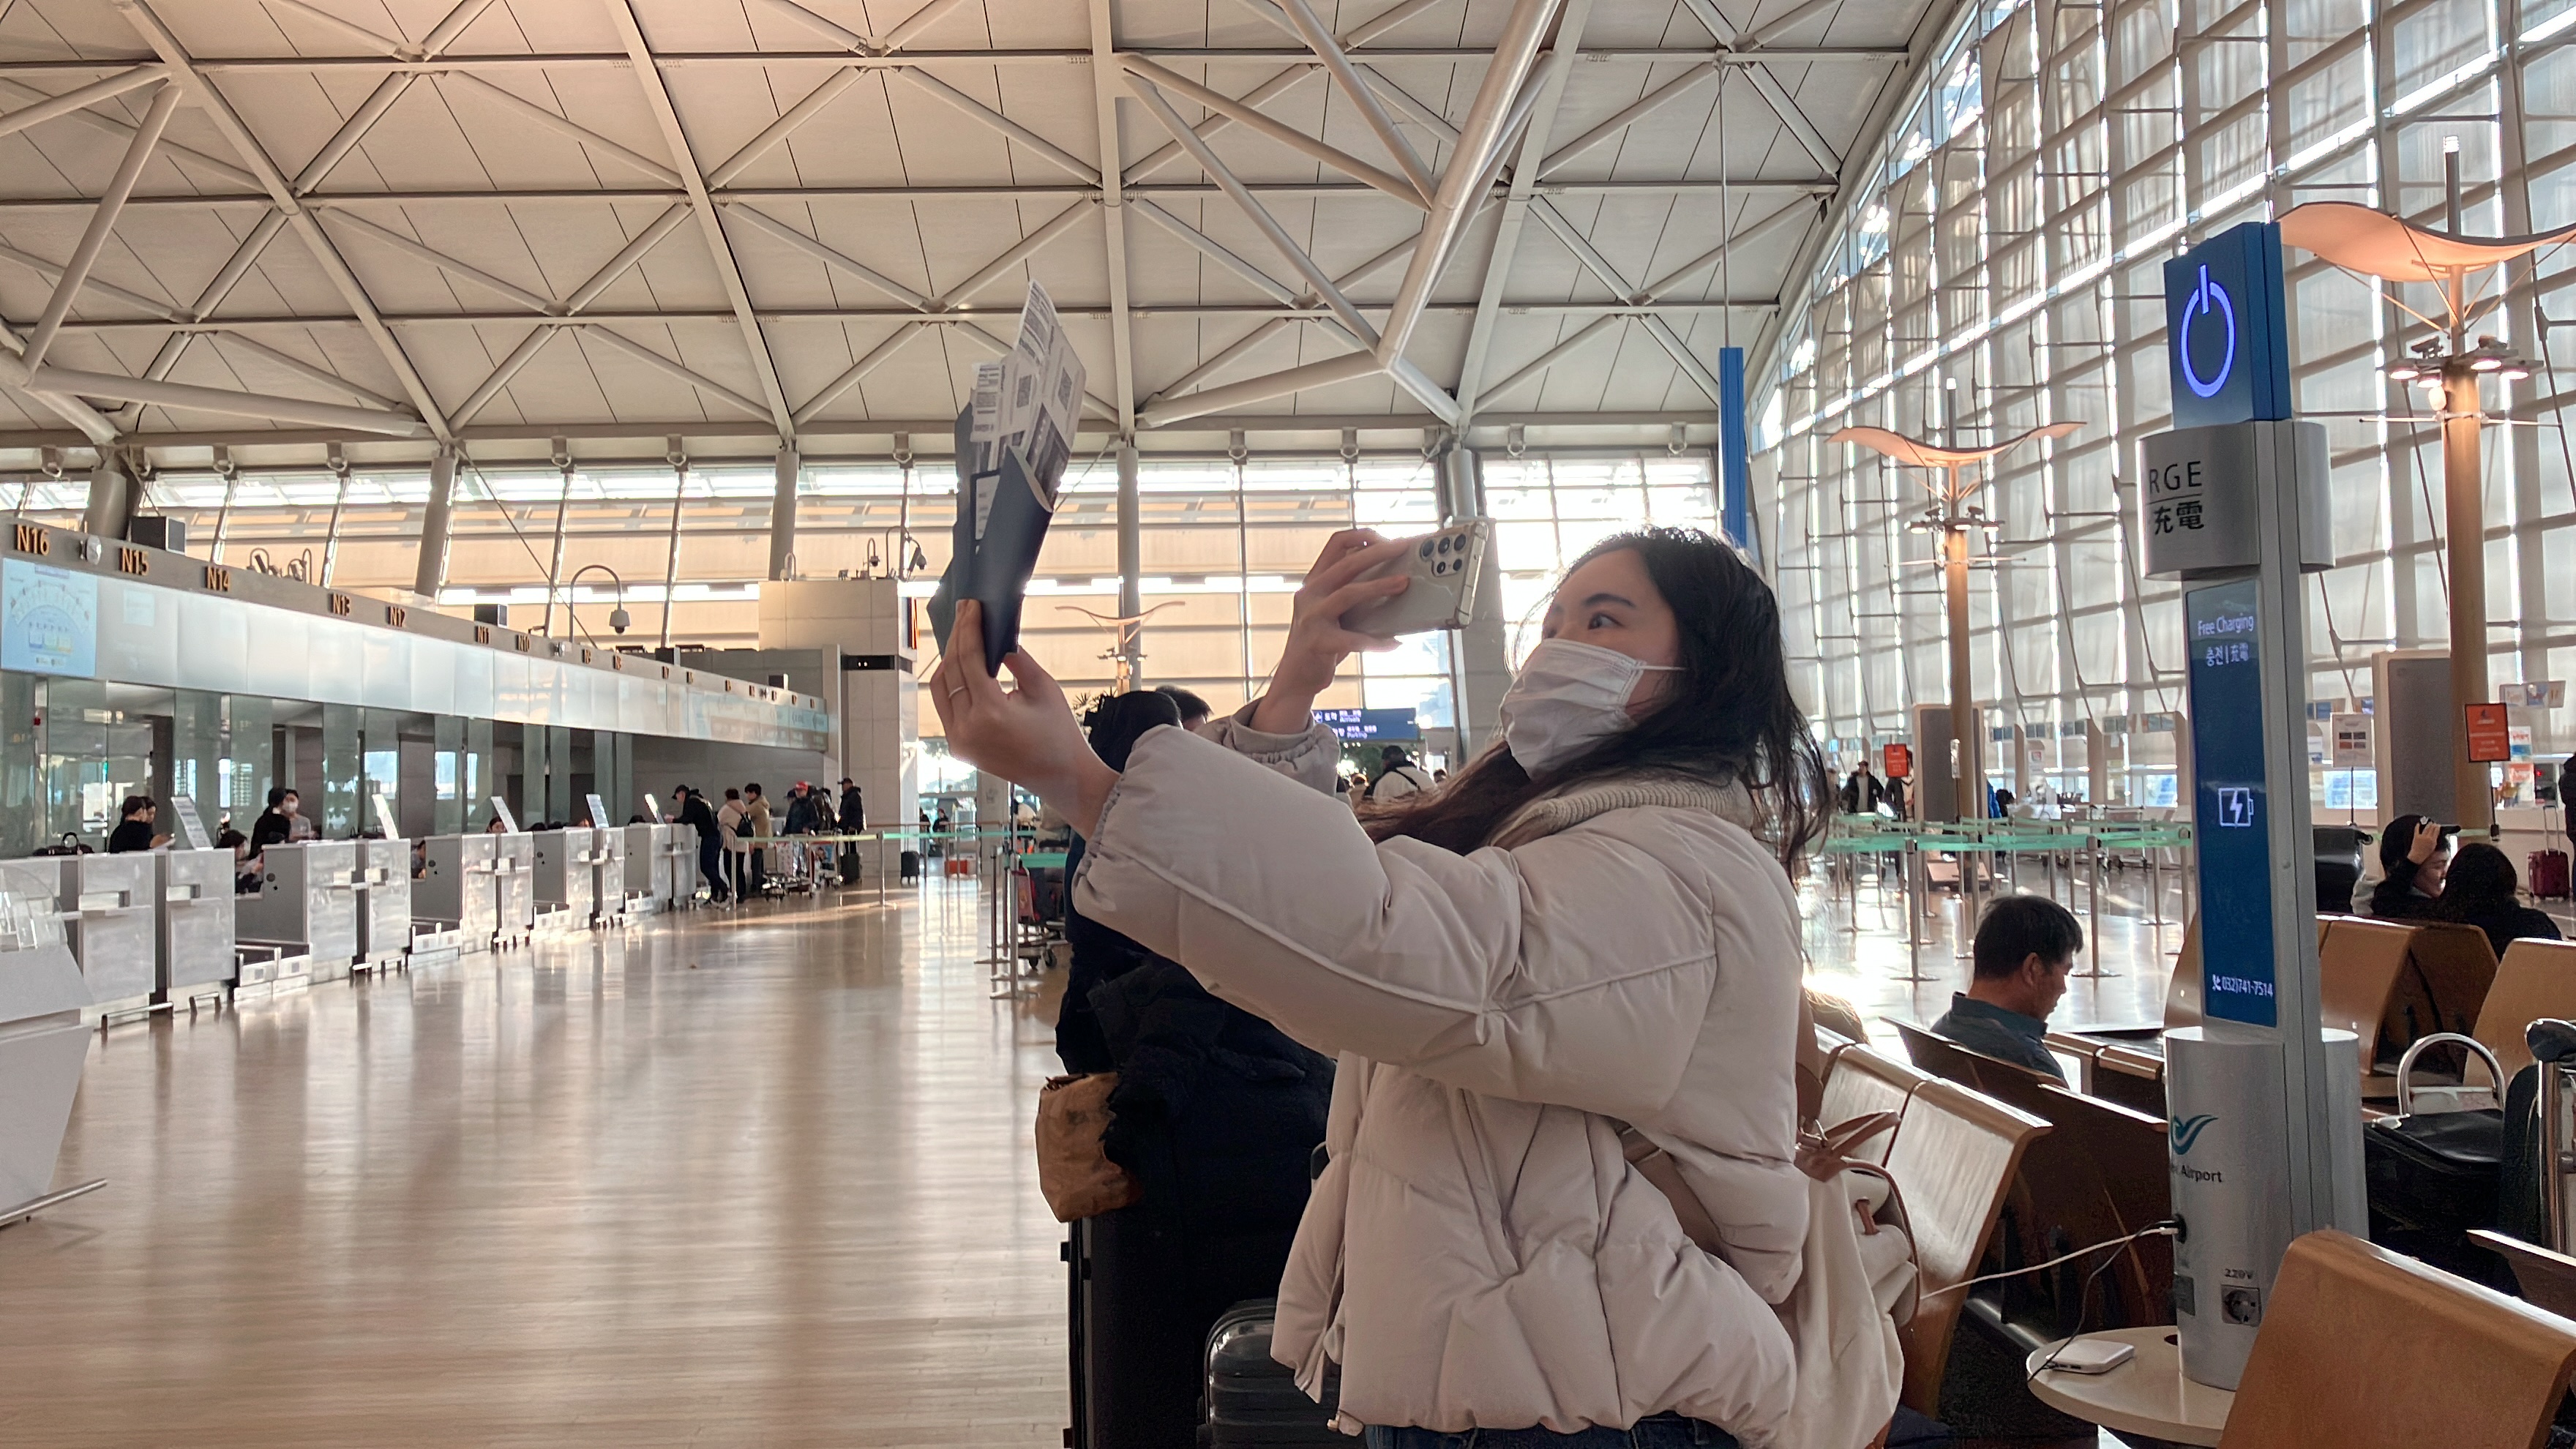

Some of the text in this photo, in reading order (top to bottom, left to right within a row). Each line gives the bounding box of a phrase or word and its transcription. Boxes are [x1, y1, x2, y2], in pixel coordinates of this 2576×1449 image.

[2149, 460, 2203, 494] RGE
[2153, 501, 2204, 536] 充電
[15, 523, 50, 557] N16
[120, 545, 150, 577] N15
[205, 565, 231, 592] N14
[331, 592, 351, 617] N13
[388, 605, 407, 628] N12
[2197, 613, 2255, 637] Free Charging
[2206, 645, 2223, 667] 충전
[2181, 1165, 2223, 1183] Airport
[2224, 1268, 2255, 1280] 220V
